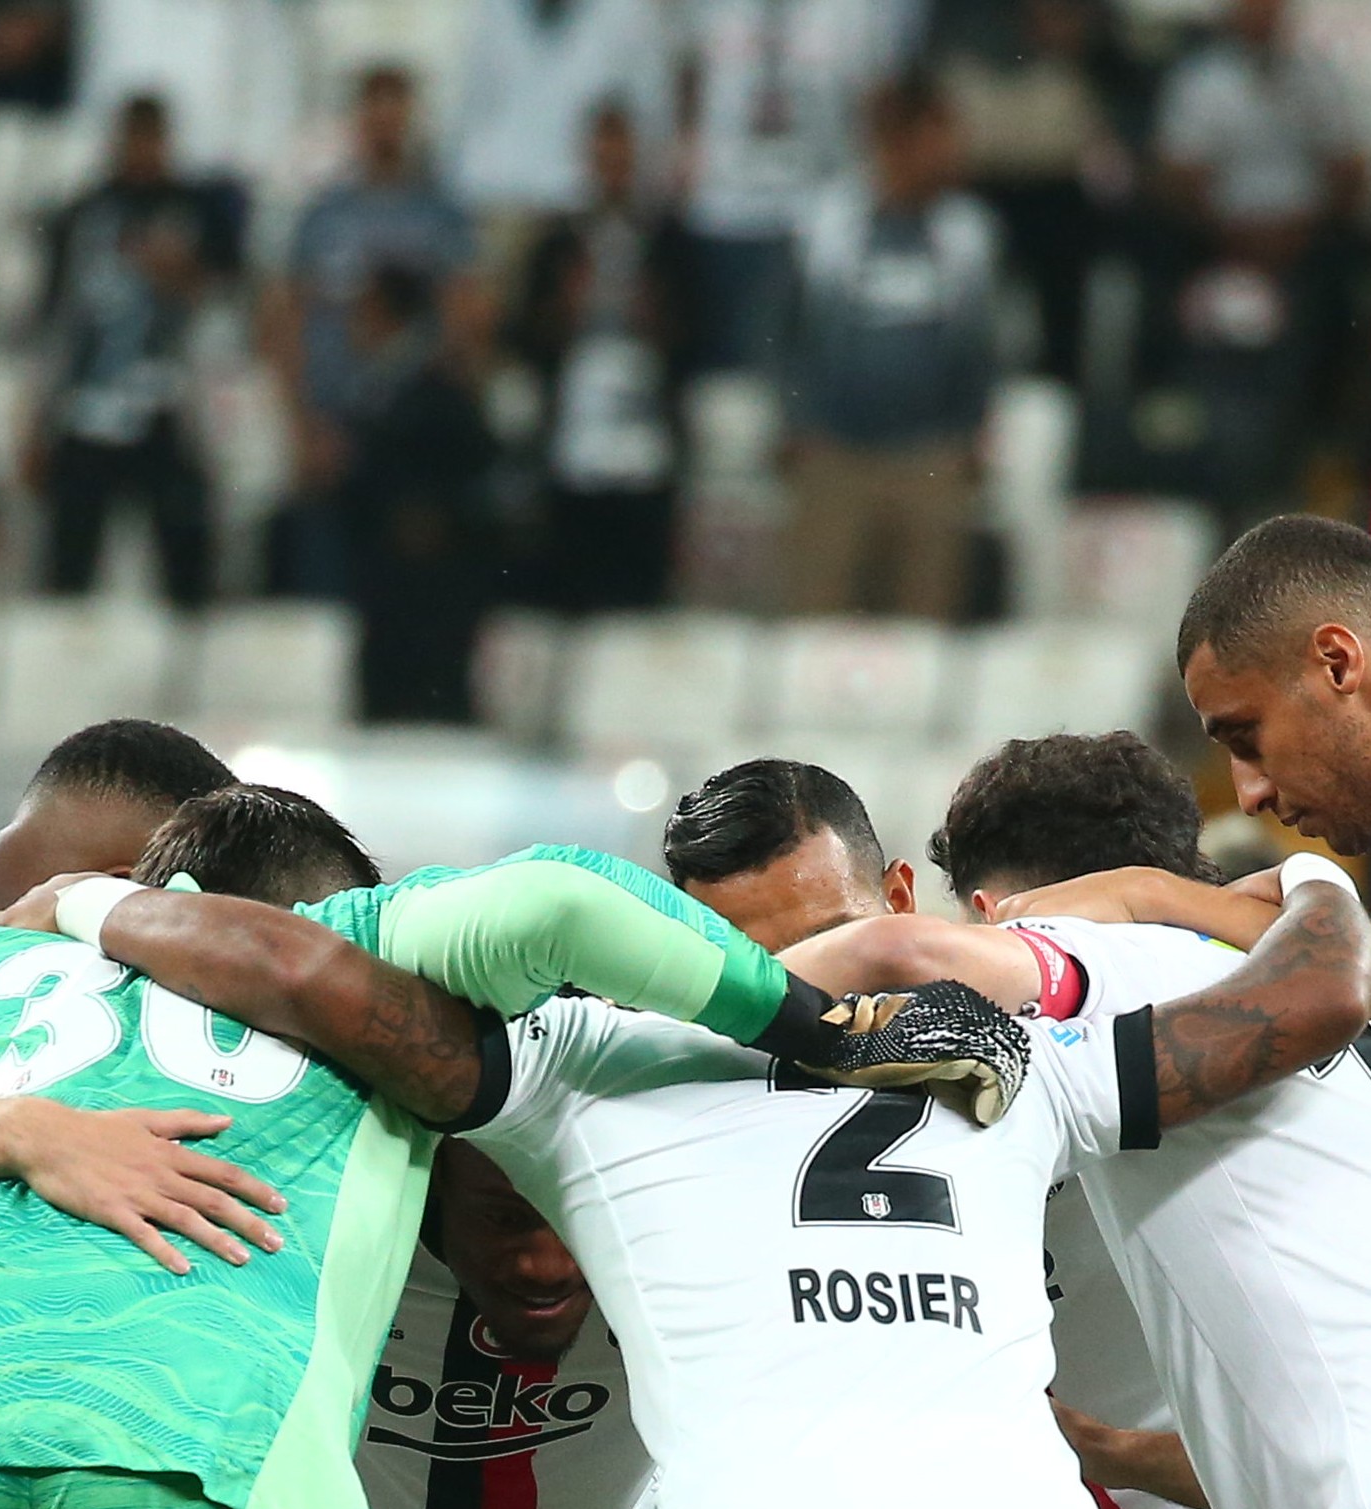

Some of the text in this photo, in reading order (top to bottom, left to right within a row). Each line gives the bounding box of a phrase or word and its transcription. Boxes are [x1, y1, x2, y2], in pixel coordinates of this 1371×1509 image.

[767, 1056, 963, 1236] 2
[787, 1267, 983, 1335] ROSIER
[371, 1363, 611, 1428] beko
